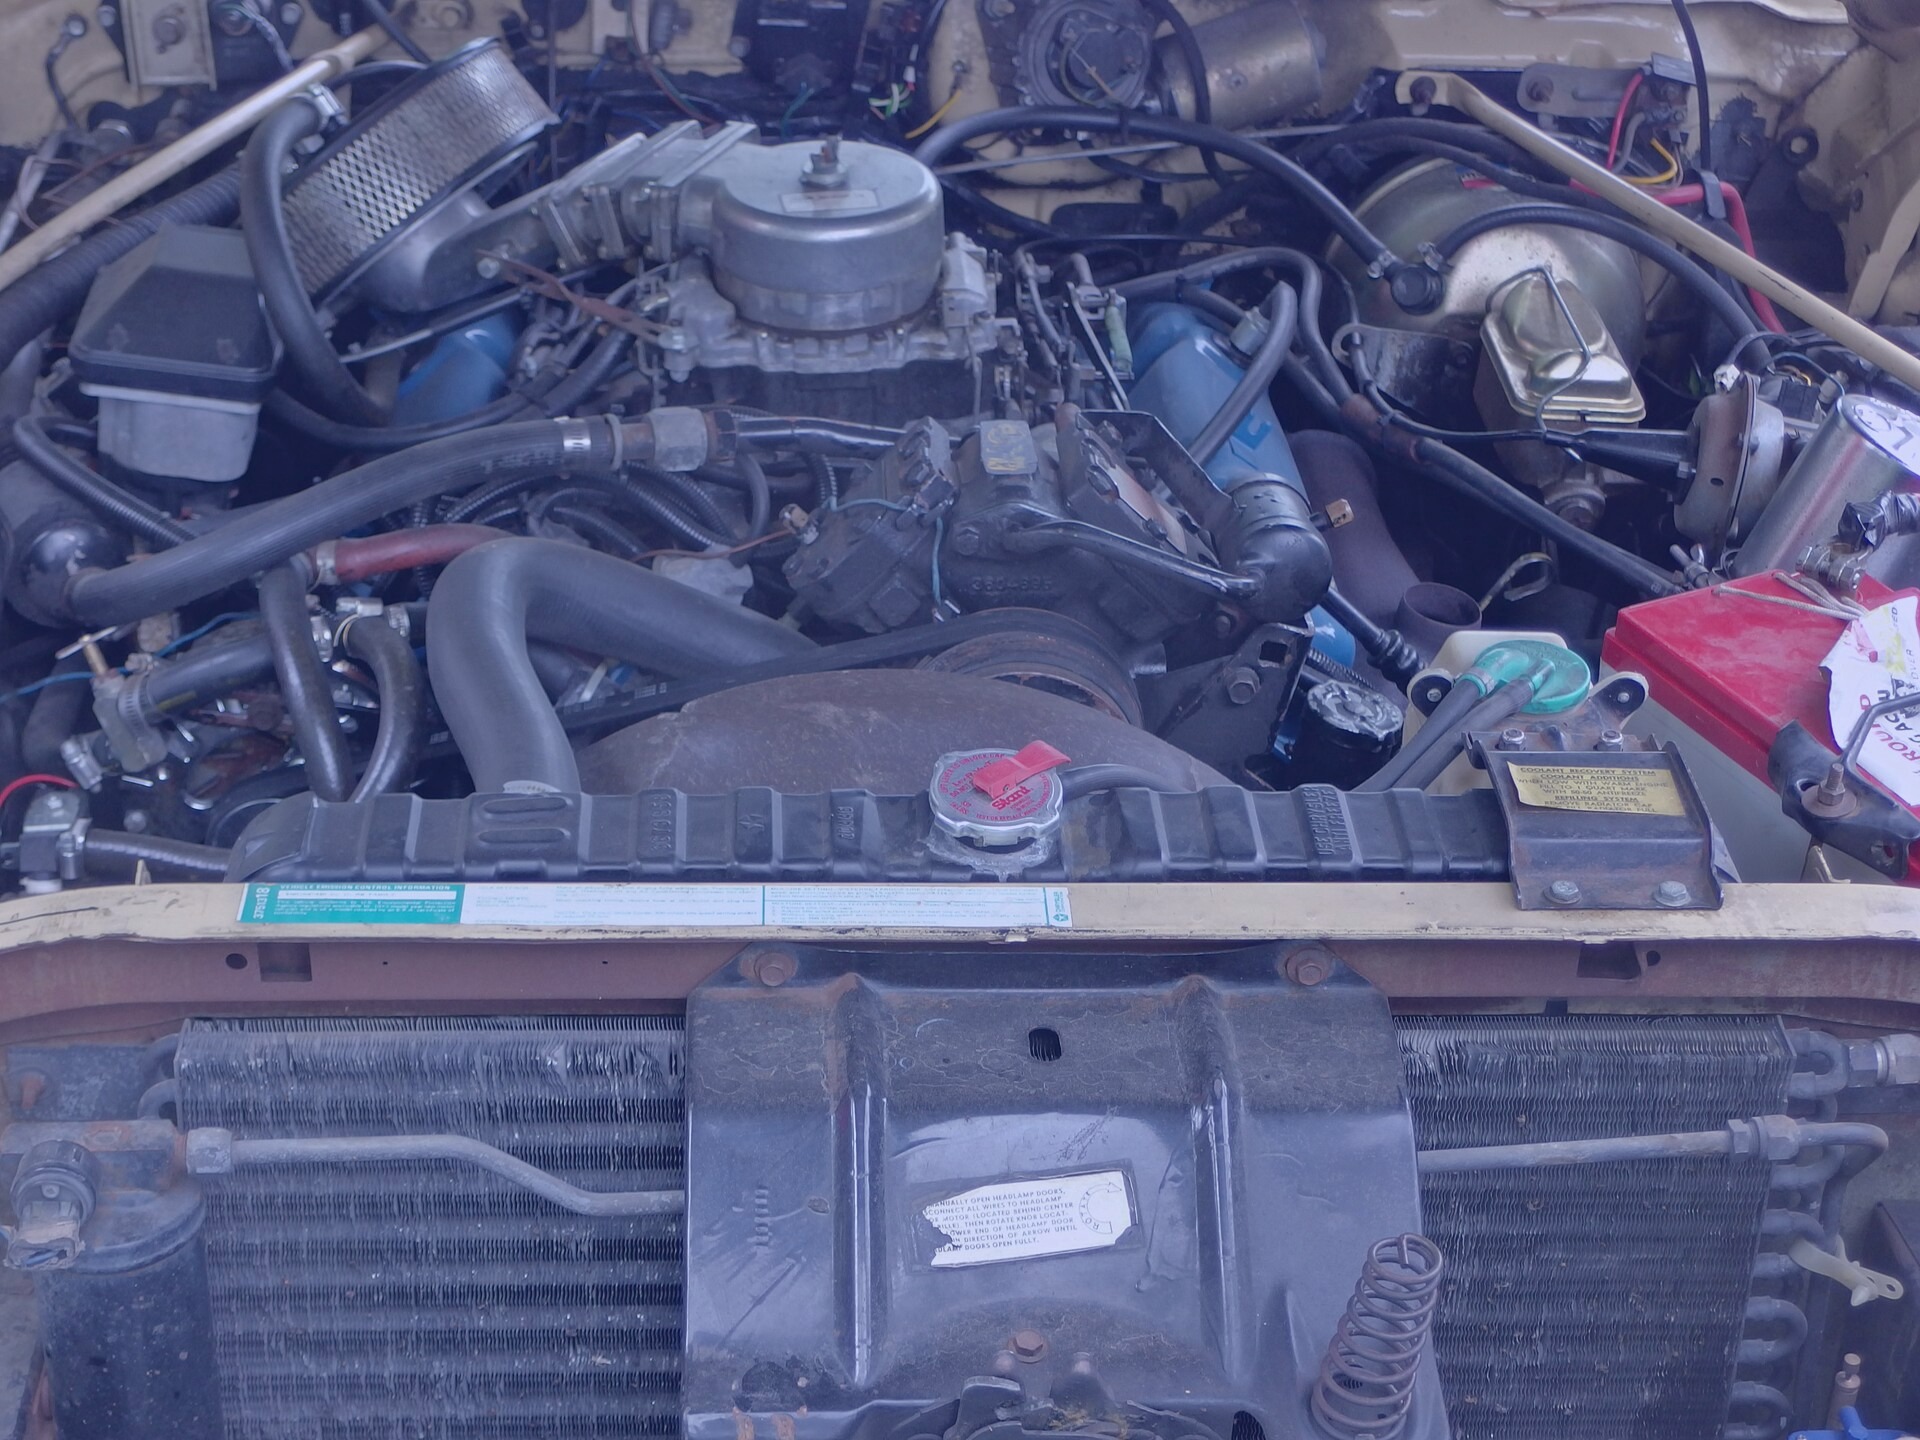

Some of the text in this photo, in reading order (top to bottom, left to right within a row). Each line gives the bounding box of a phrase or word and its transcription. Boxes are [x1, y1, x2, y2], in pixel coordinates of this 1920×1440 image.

[991, 785, 1032, 811] Stant
[1302, 786, 1336, 855] USE CHRYSLER
[992, 1191, 1034, 1202] HEADLAMP
[1036, 1188, 1066, 1197] DOORS,
[982, 1202, 1006, 1210] WIRES
[1020, 1196, 1062, 1206] HEADLAMP
[943, 1214, 969, 1222] MOTOR
[972, 1209, 1010, 1219] (LOCATED
[1013, 1206, 1041, 1214] BEHIND
[1043, 1202, 1073, 1211] CENTER
[964, 1220, 984, 1228] THEN
[985, 1217, 1013, 1225] ROTATE
[1006, 1221, 1047, 1230] HEADLAMP
[1051, 1217, 1073, 1225] DOOR
[963, 1234, 1004, 1243] DIRECTION
[1022, 1228, 1051, 1236] ARROW
[964, 1242, 990, 1250] DOORS
